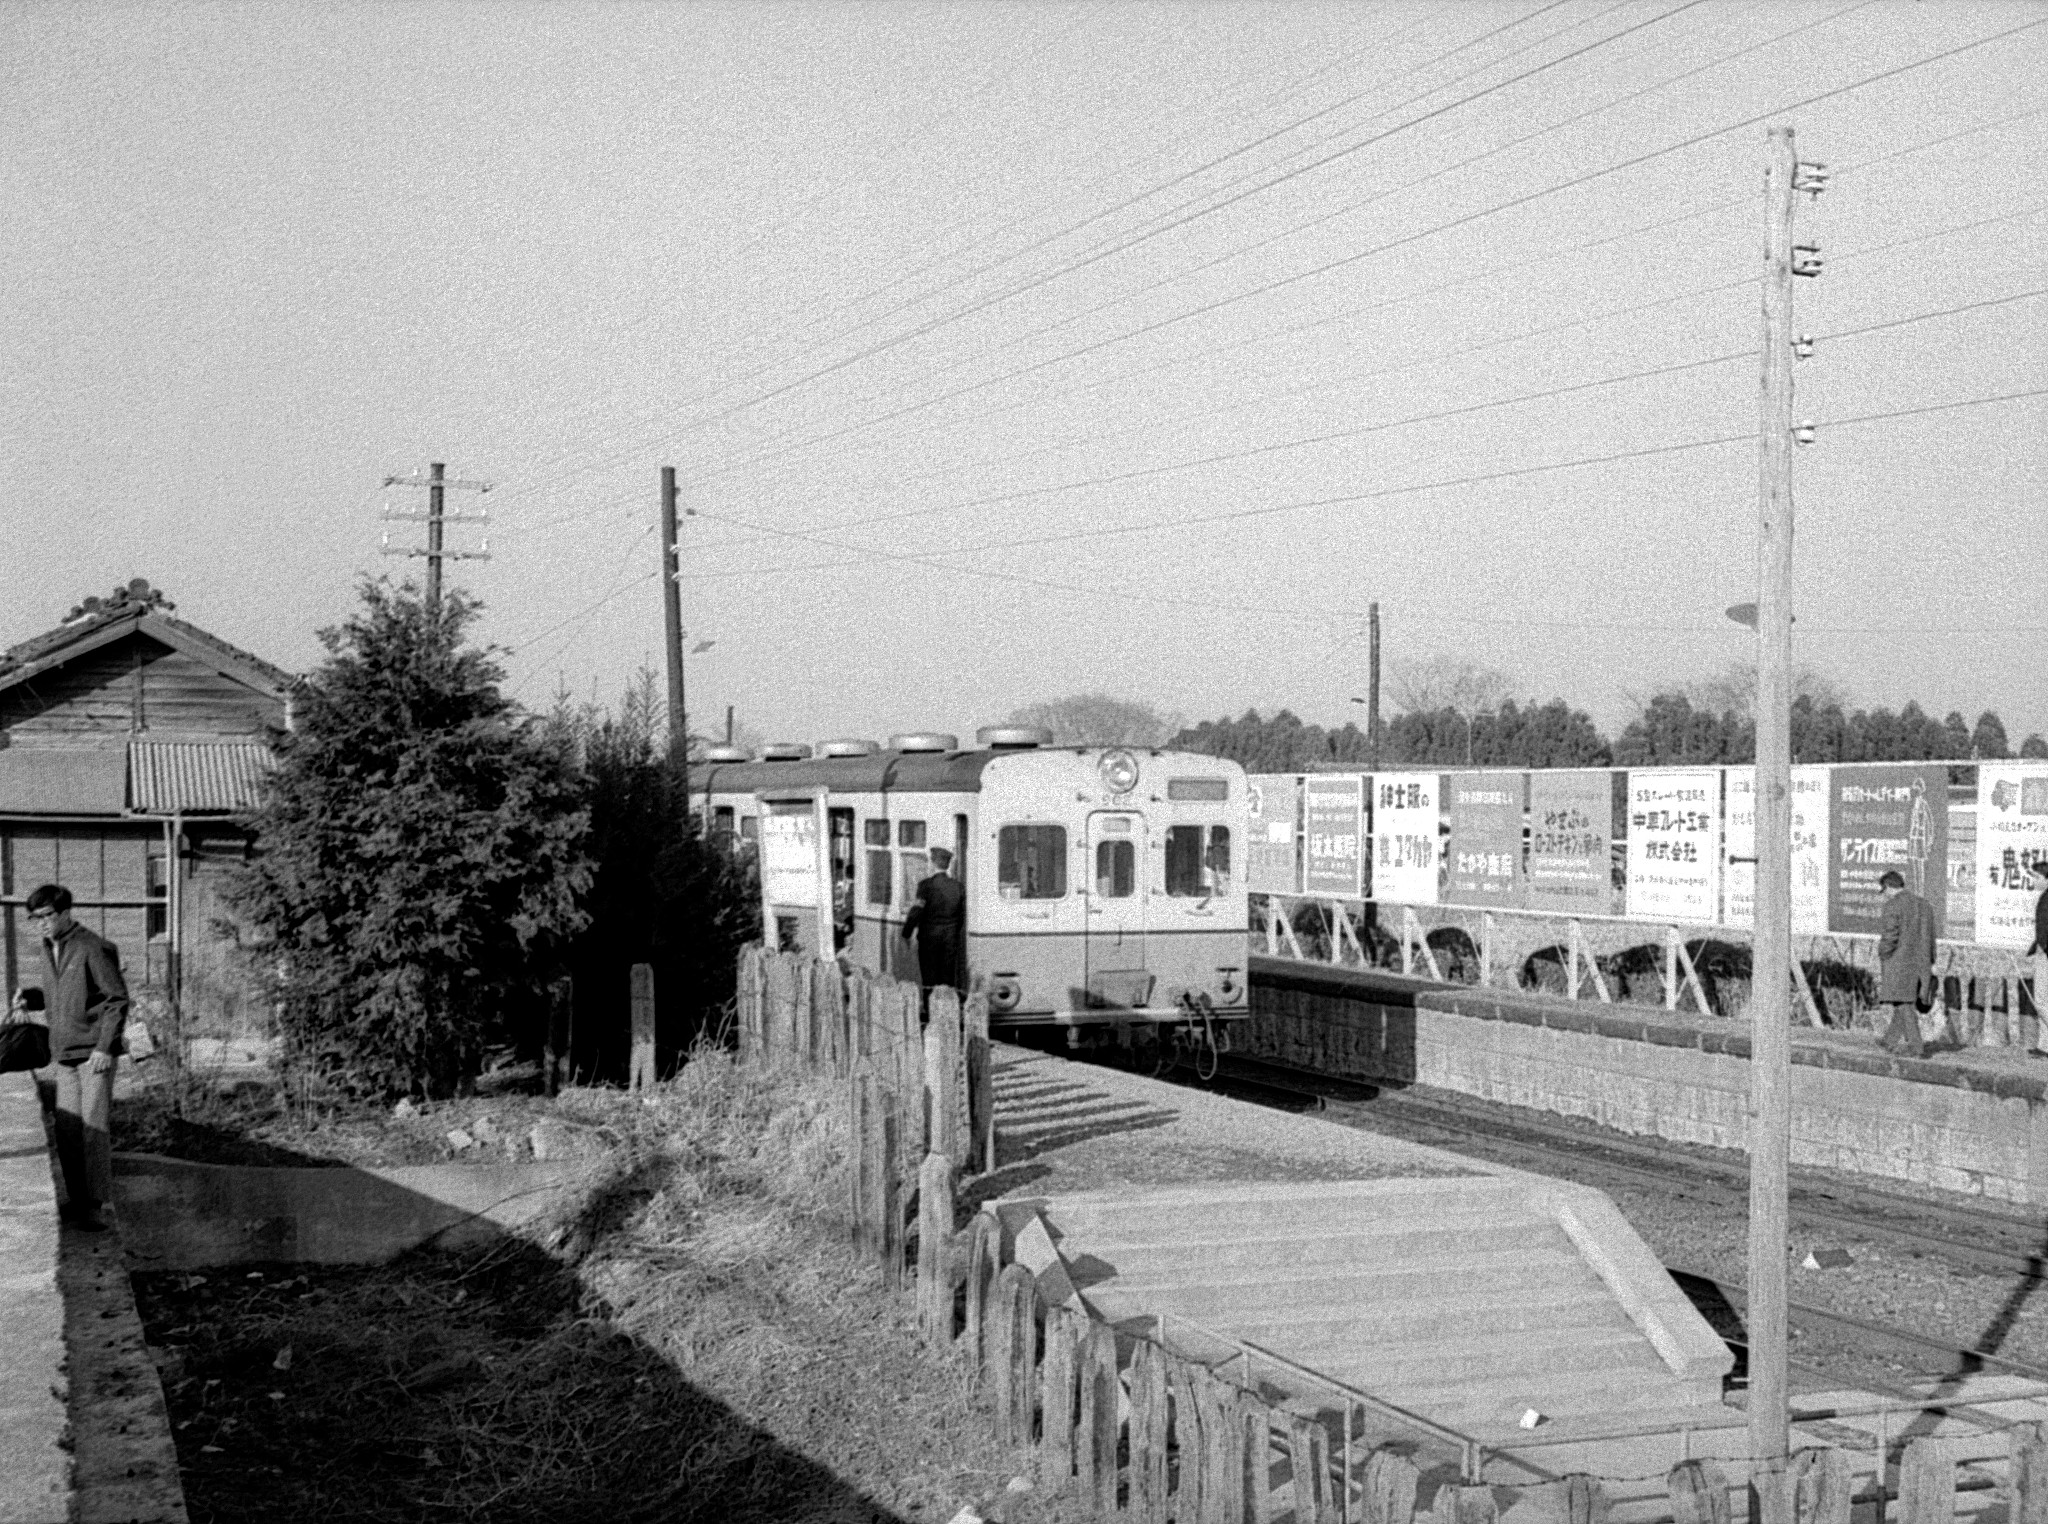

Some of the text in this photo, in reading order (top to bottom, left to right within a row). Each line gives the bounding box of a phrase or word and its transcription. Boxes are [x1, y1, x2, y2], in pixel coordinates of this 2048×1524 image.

[1380, 783, 1429, 809] 紳士服の
[1646, 840, 1697, 863] 株式会社
